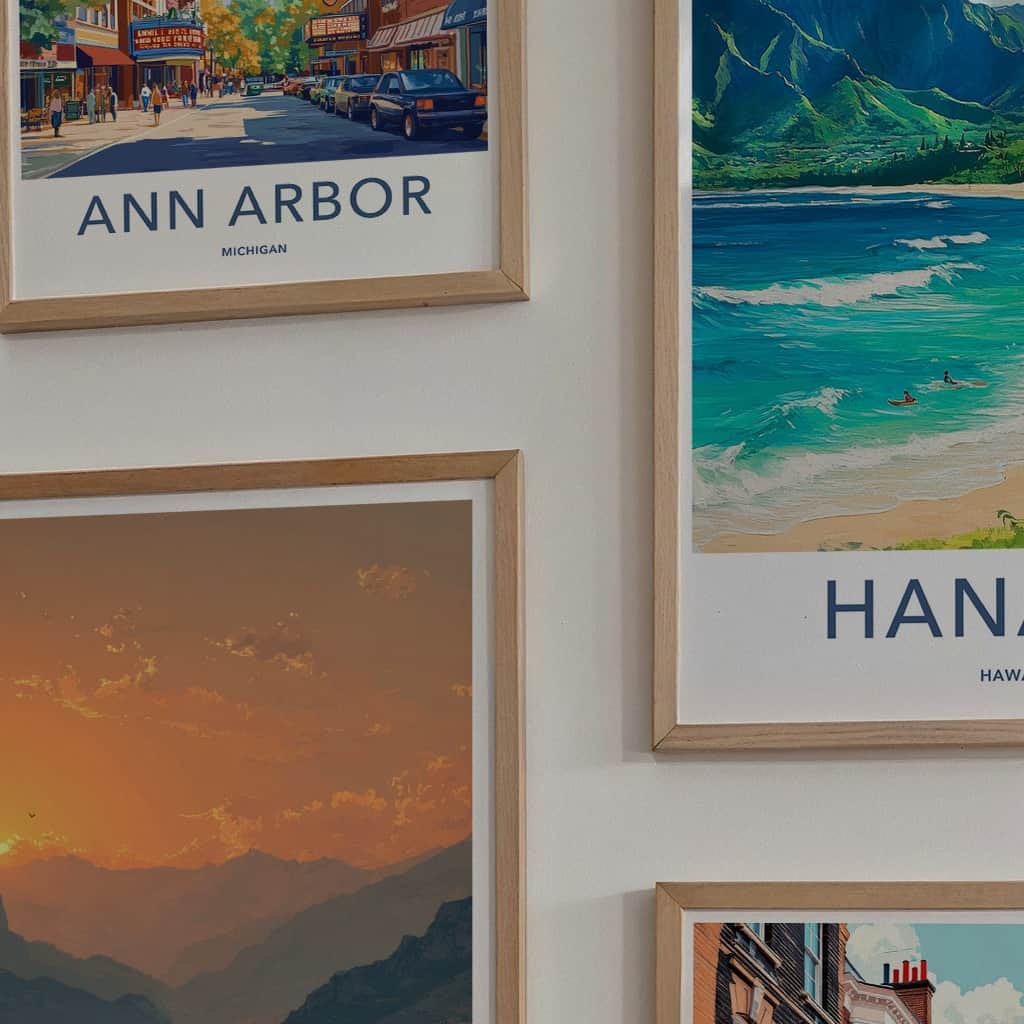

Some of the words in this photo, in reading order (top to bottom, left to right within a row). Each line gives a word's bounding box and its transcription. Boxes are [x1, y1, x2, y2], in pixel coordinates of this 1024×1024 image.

[78, 189, 204, 235] ANN
[229, 175, 431, 226] ARBOR
[222, 244, 287, 257] MICHIGAN
[827, 578, 1024, 639] HAN
[981, 669, 1024, 682] HAW
